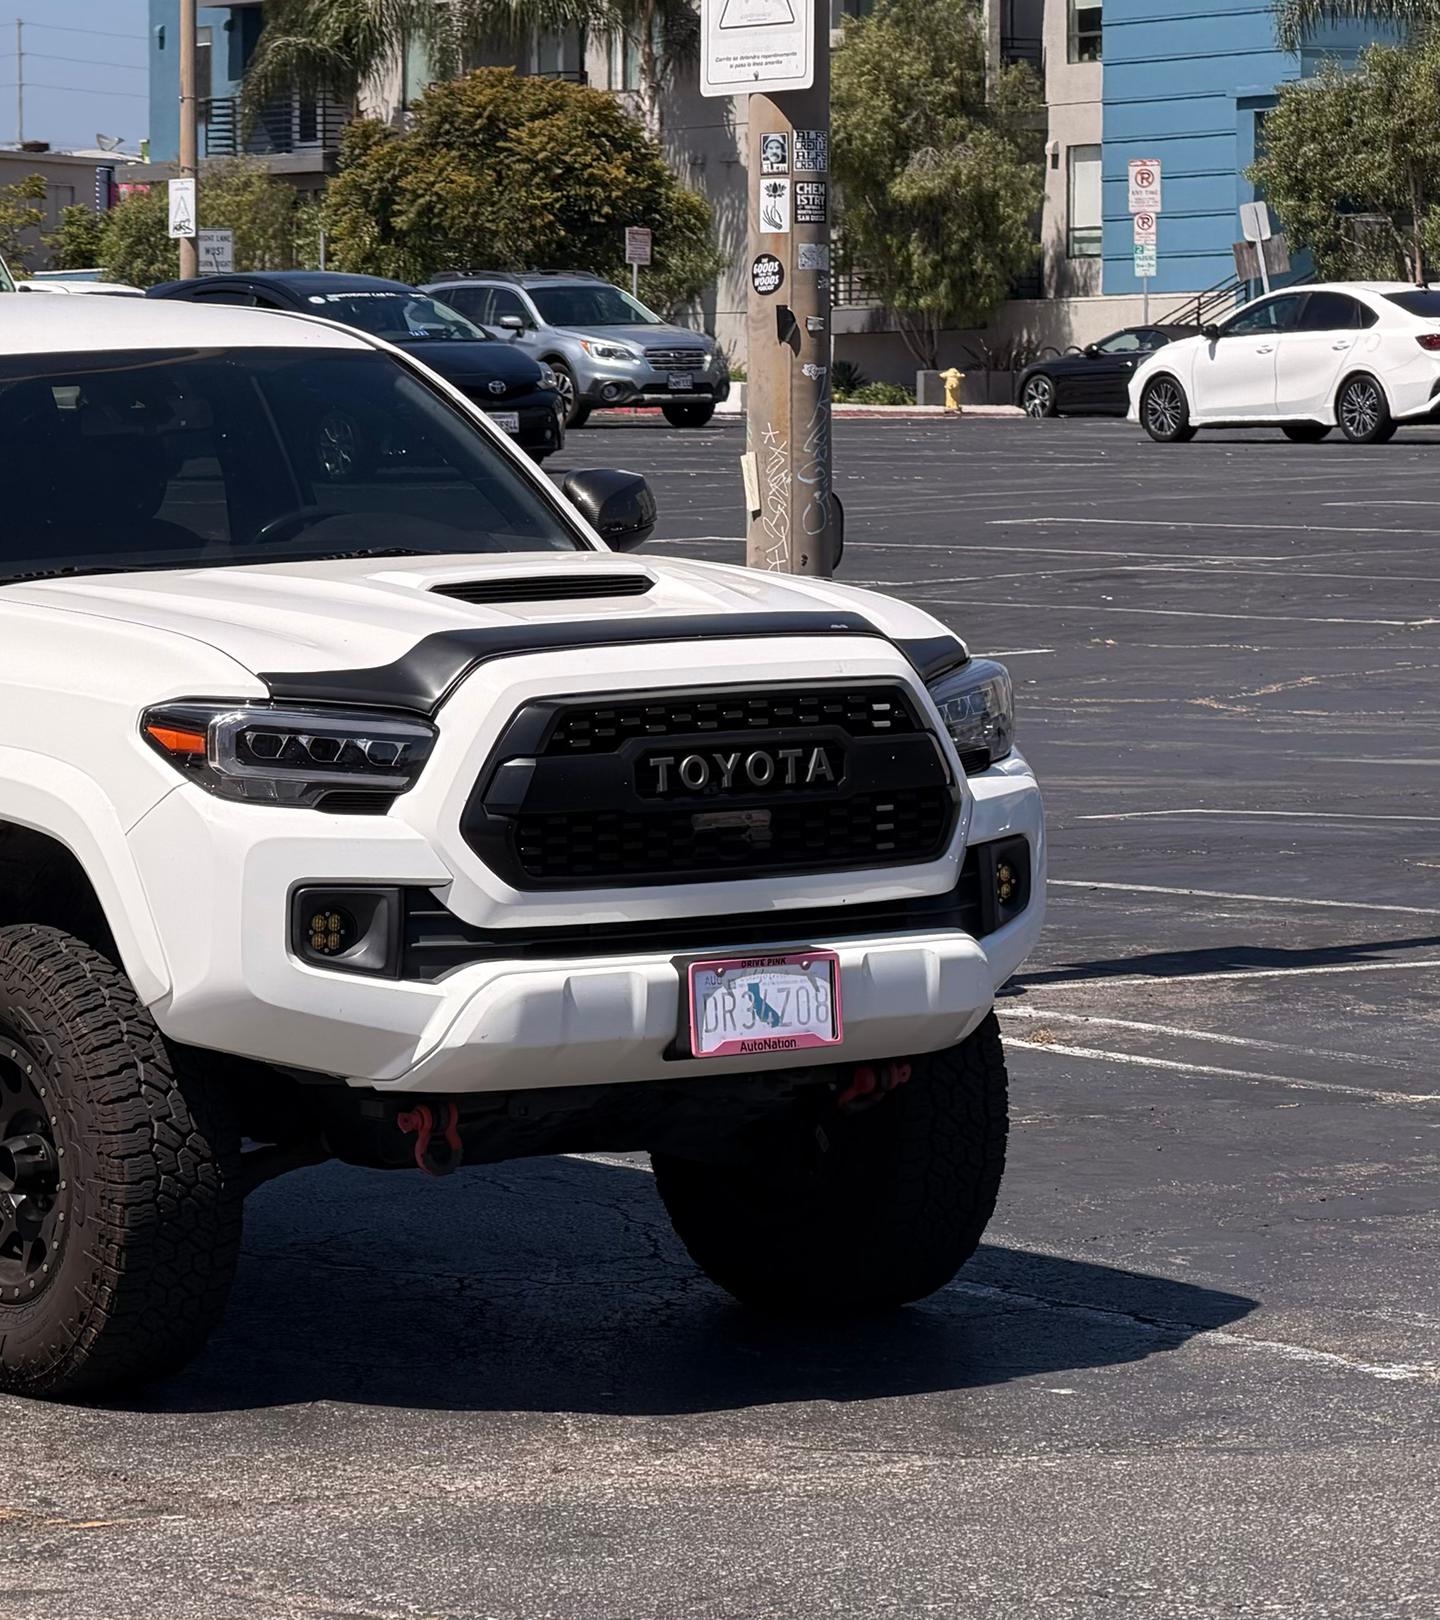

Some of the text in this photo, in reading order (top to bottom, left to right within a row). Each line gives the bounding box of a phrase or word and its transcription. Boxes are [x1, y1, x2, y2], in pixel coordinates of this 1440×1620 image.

[796, 194, 824, 204] ISTRY
[753, 262, 779, 274] GOODS
[754, 274, 779, 287] WOODS
[649, 747, 835, 794] TOYOTA
[741, 957, 786, 968] DRIVE PINK
[740, 1038, 796, 1052] AutoNation
